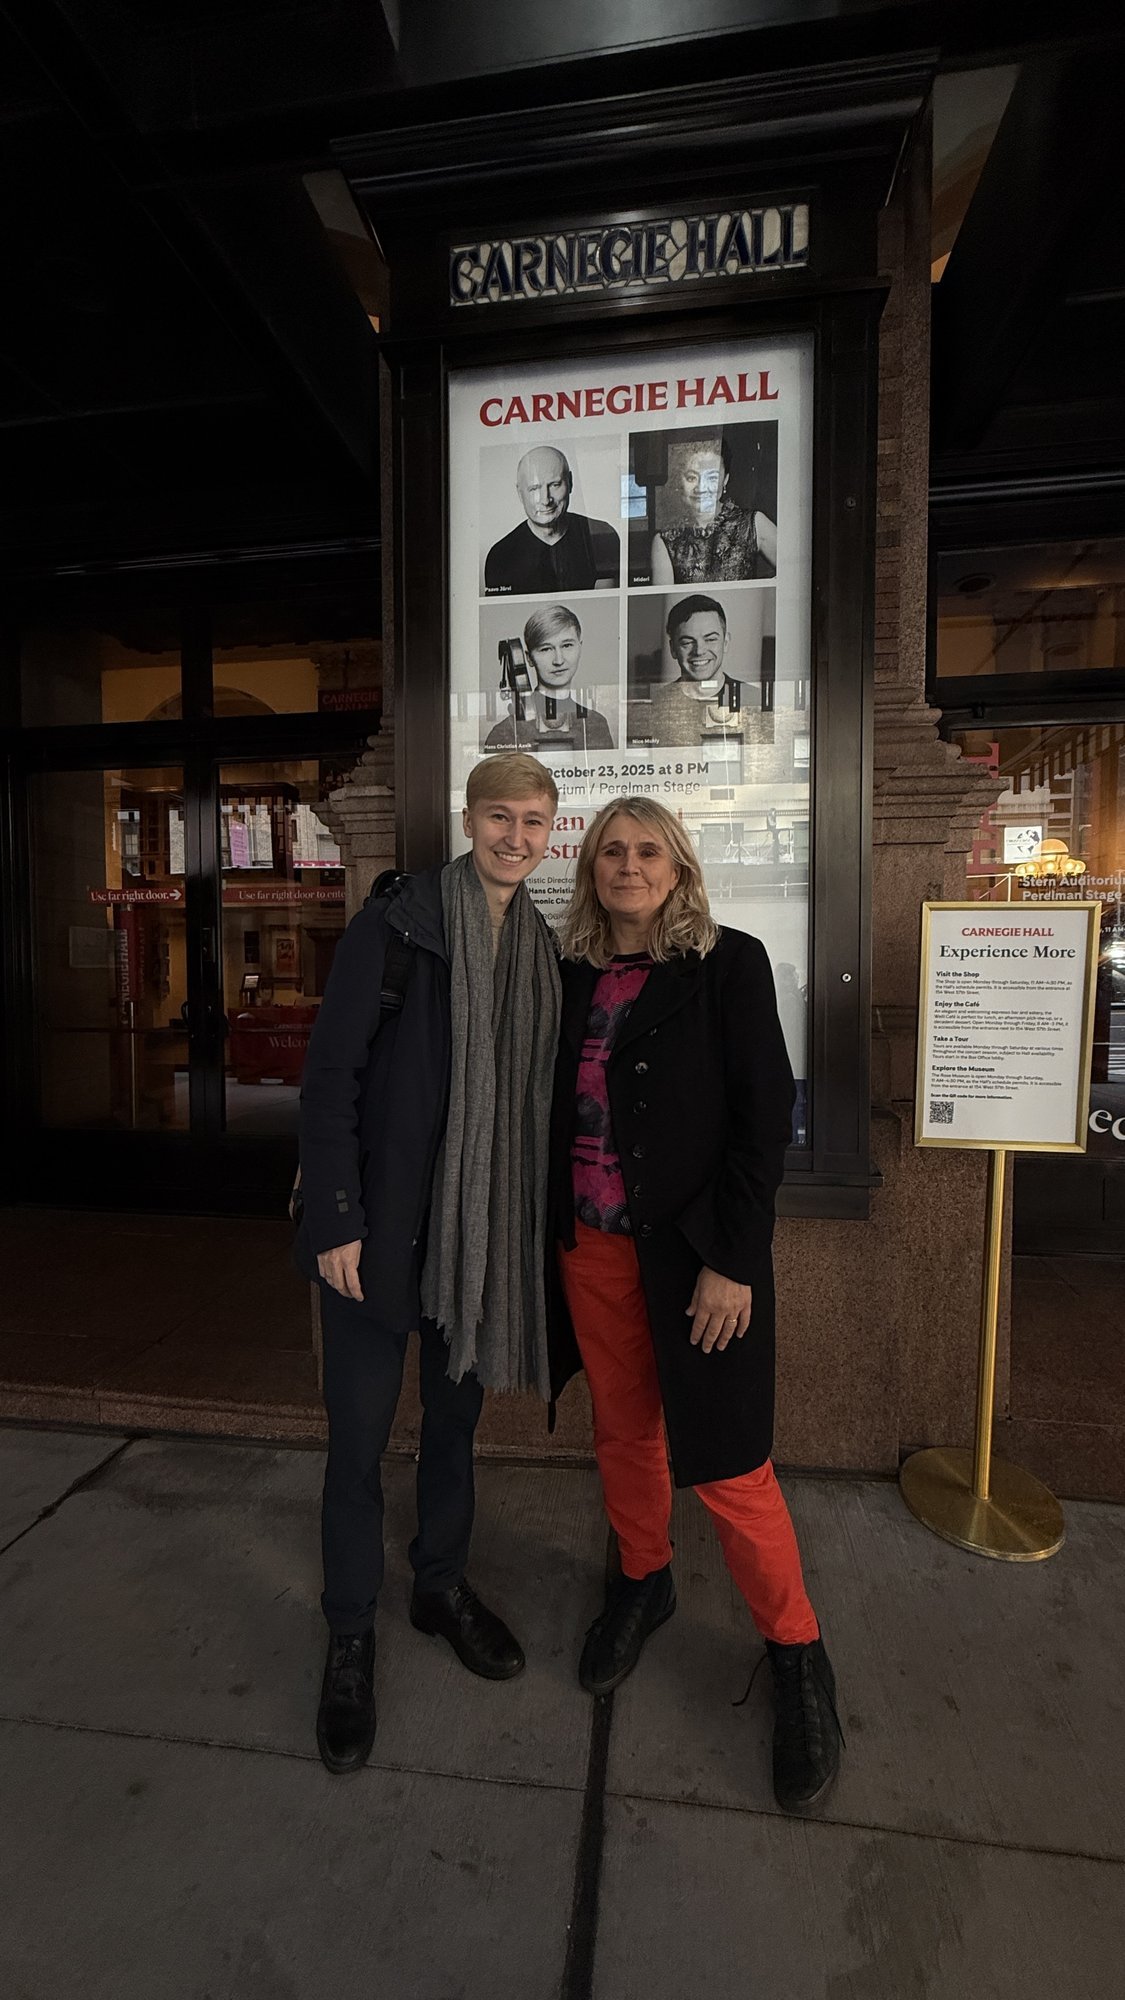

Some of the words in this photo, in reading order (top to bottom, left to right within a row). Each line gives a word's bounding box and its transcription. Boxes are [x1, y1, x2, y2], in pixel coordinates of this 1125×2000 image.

[450, 222, 673, 300] CARNEGIE
[687, 207, 808, 272] HALL
[480, 382, 668, 427] CARNEGIE
[676, 371, 779, 408] HALL
[322, 691, 379, 704] CARNEGIE
[598, 766, 618, 779] 23,
[621, 764, 654, 776] 2025
[659, 765, 671, 775] at
[675, 764, 683, 774] 8
[688, 762, 709, 774] PM
[600, 782, 659, 794] Perelman
[664, 781, 700, 794] Stage
[1023, 876, 1056, 887] Stern
[91, 891, 106, 901] Use
[108, 891, 120, 900] far
[122, 890, 145, 902] right
[146, 890, 169, 900] door.
[239, 890, 256, 900] Use
[257, 890, 270, 899] far
[272, 890, 292, 900] right
[294, 890, 315, 899] door
[327, 890, 345, 898] ente
[1023, 890, 1082, 900] Perelman
[1086, 890, 1122, 902] Stage
[962, 927, 1021, 937] CARNEGIE
[1023, 927, 1054, 937] HALL
[940, 945, 1028, 961] Experience
[1032, 946, 1076, 959] More
[269, 1035, 310, 1048] Welco
